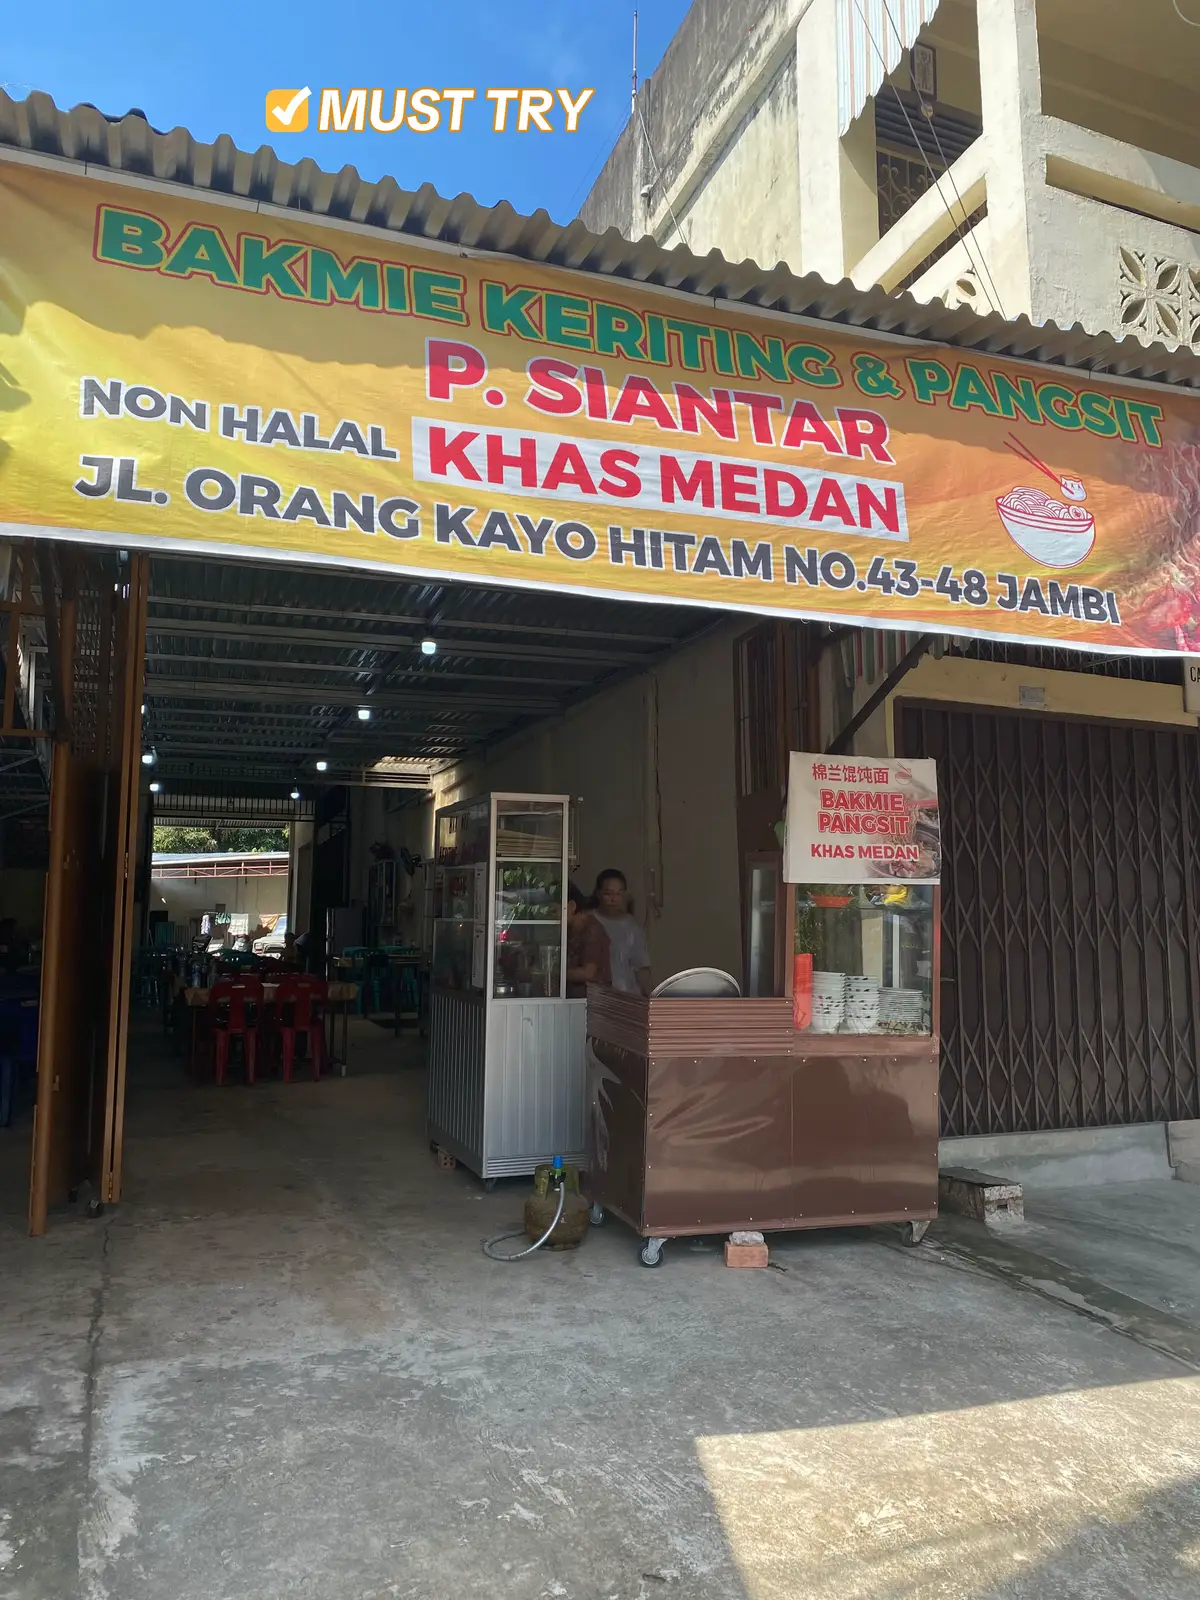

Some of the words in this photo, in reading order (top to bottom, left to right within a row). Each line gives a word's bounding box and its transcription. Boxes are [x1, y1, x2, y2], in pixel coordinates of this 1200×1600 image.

[94, 204, 470, 326] BAKMIE
[481, 279, 843, 393] KERITING
[851, 353, 904, 400] &
[905, 357, 1164, 448] PANGSIT
[80, 377, 207, 430] NON
[220, 405, 399, 461] HALAL
[424, 336, 505, 407] P.
[526, 356, 897, 465] SIANTAR
[428, 425, 641, 499] KHAS
[660, 455, 898, 532] MEDAN
[75, 454, 168, 506] JL.
[185, 467, 420, 539] ORANG
[434, 502, 597, 561] KAYO
[608, 526, 774, 582] HITAM
[784, 547, 989, 606] NO.43-48
[997, 573, 1122, 625] JAMBI
[812, 763, 889, 785] 棉兰馄饨面
[820, 789, 904, 812] BAKMIE
[811, 844, 854, 859] KHAS
[858, 846, 919, 860] MEDAN
[818, 812, 909, 834] PANGSIT
